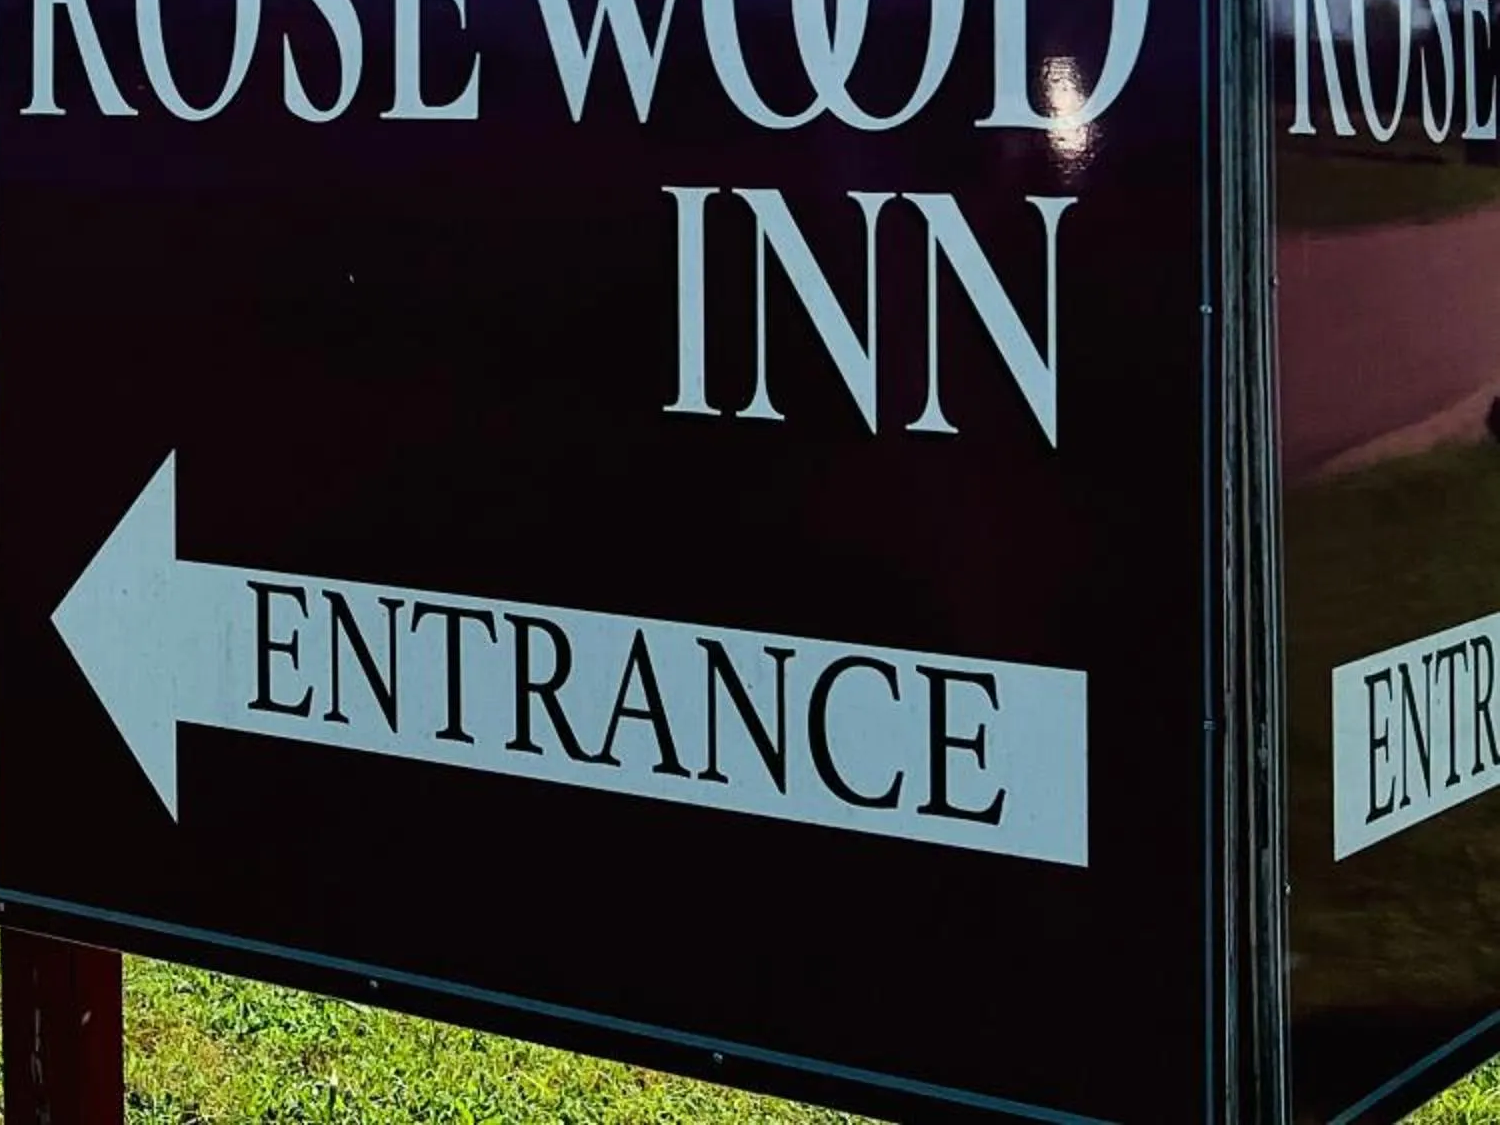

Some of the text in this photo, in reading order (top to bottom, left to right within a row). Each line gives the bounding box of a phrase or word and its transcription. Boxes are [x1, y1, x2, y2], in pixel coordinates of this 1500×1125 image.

[661, 185, 1078, 450] INN
[247, 580, 1006, 826] ENTRANCE
[1363, 634, 1500, 825] ENTR
